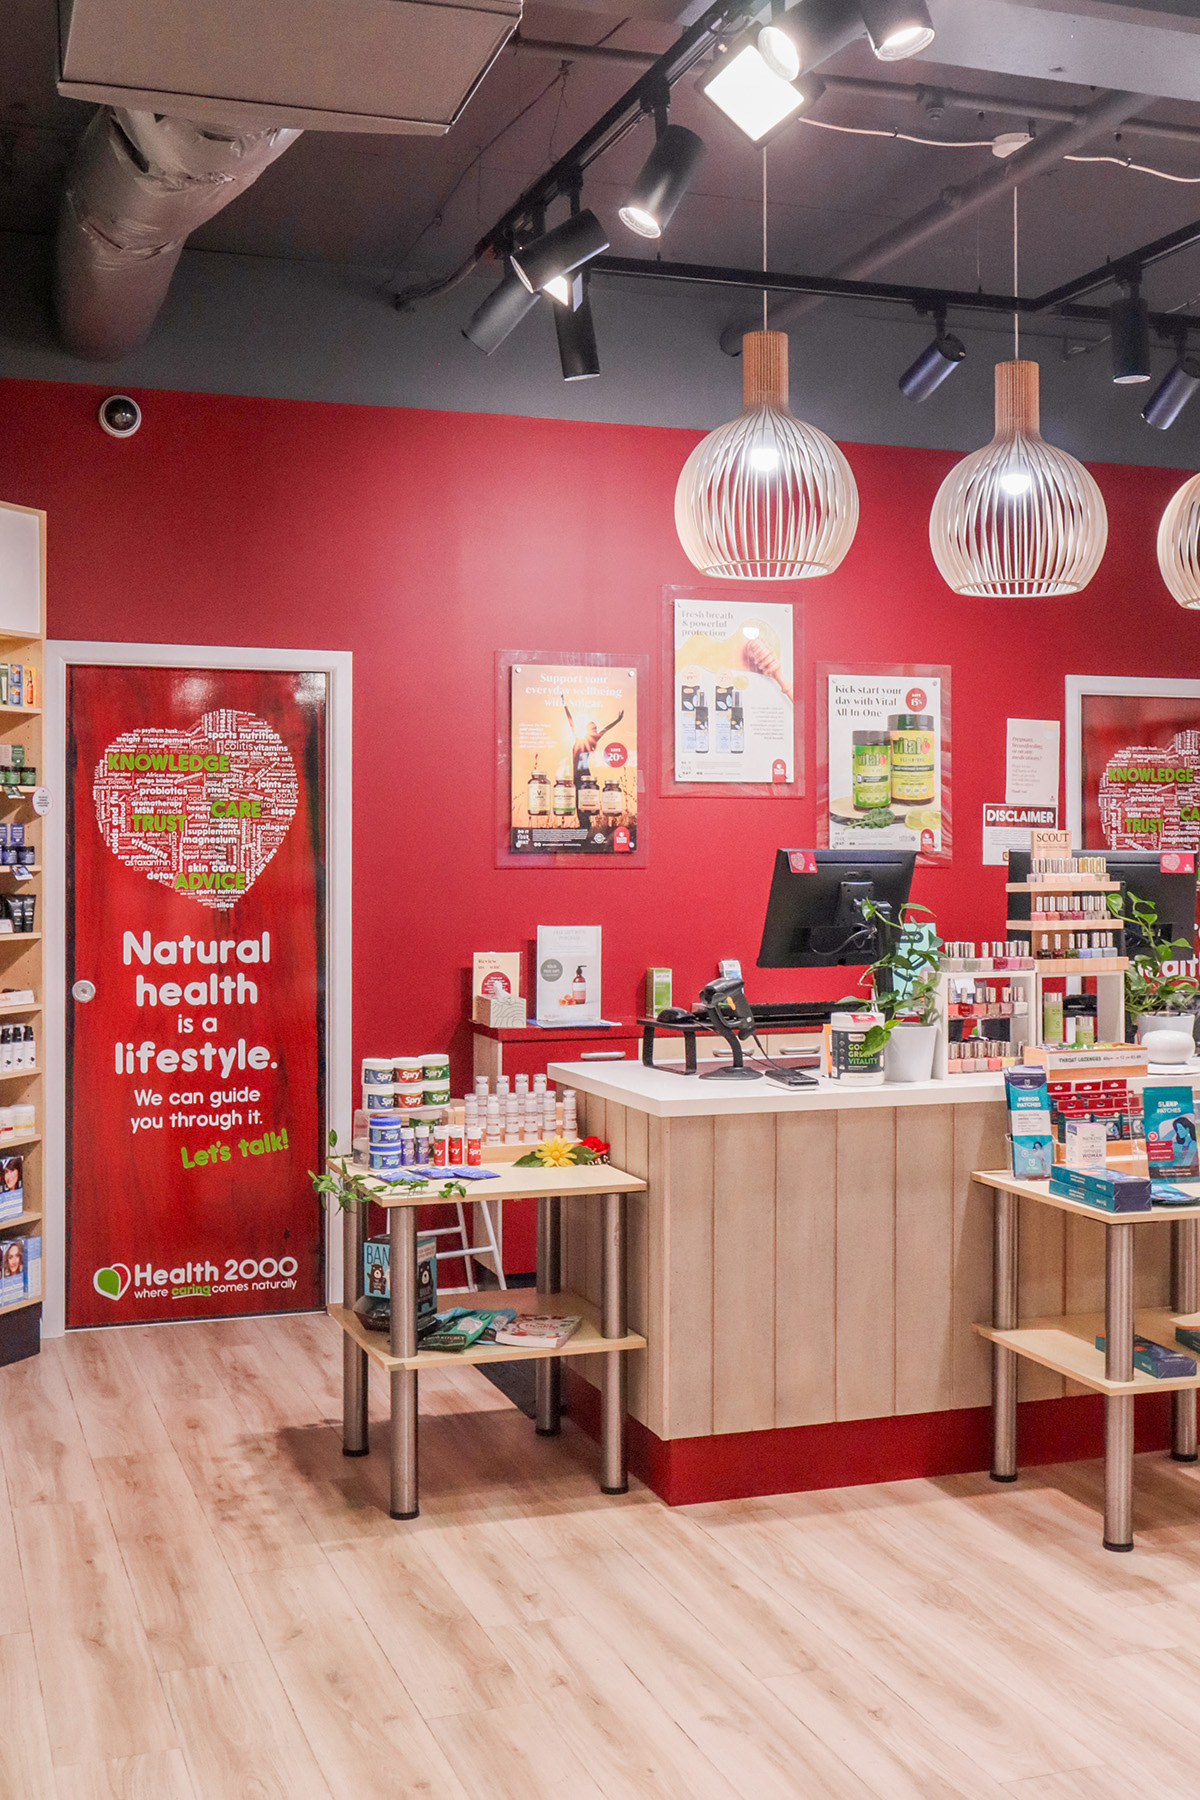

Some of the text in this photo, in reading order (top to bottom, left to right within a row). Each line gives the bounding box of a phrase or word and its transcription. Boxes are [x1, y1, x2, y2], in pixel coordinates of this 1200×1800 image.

[706, 611, 733, 619] breath
[681, 629, 726, 638] protection
[540, 673, 608, 685] Support your
[525, 685, 622, 698] everyday wellbeing
[835, 685, 902, 696] Kick start your
[544, 697, 567, 707] with
[835, 696, 897, 706] day with Vital
[836, 708, 882, 717] All In One
[208, 732, 237, 741] sports
[107, 753, 230, 772] KNOWLEDGE
[607, 753, 624, 762] 20%
[1108, 767, 1194, 782] KNOWLEDGE
[257, 781, 282, 790] joints
[140, 787, 187, 796] probiotics
[131, 800, 182, 808] aromatherapy
[210, 800, 261, 818] CARE
[110, 807, 119, 825] and
[270, 808, 296, 817] sleep
[986, 809, 1054, 823] DISCLAIMER
[131, 814, 187, 832] TRUST
[1125, 818, 1164, 833] TRUST
[187, 828, 241, 836] supplements
[1036, 833, 1070, 842] SCOUT
[110, 828, 119, 854] colds
[183, 836, 237, 845] magnesium
[131, 838, 168, 859] vitamins
[187, 863, 237, 872] skin care
[146, 871, 174, 880] detox
[175, 872, 246, 889] ADVICE
[123, 930, 270, 966] Natural
[136, 972, 258, 1007] health
[177, 1014, 217, 1033] is a
[115, 1038, 278, 1079] lifestyle.
[402, 1071, 420, 1080] Spry
[424, 1069, 443, 1078] Spry
[133, 1086, 261, 1108] We can guide
[404, 1097, 422, 1105] Spry
[432, 1094, 449, 1102] Spry
[130, 1109, 263, 1134] you through it.
[384, 1132, 399, 1140] Spry
[180, 1127, 289, 1169] Let's talk!
[134, 1256, 298, 1287] Health 2000
[134, 1278, 297, 1299] where caring comes naturally
